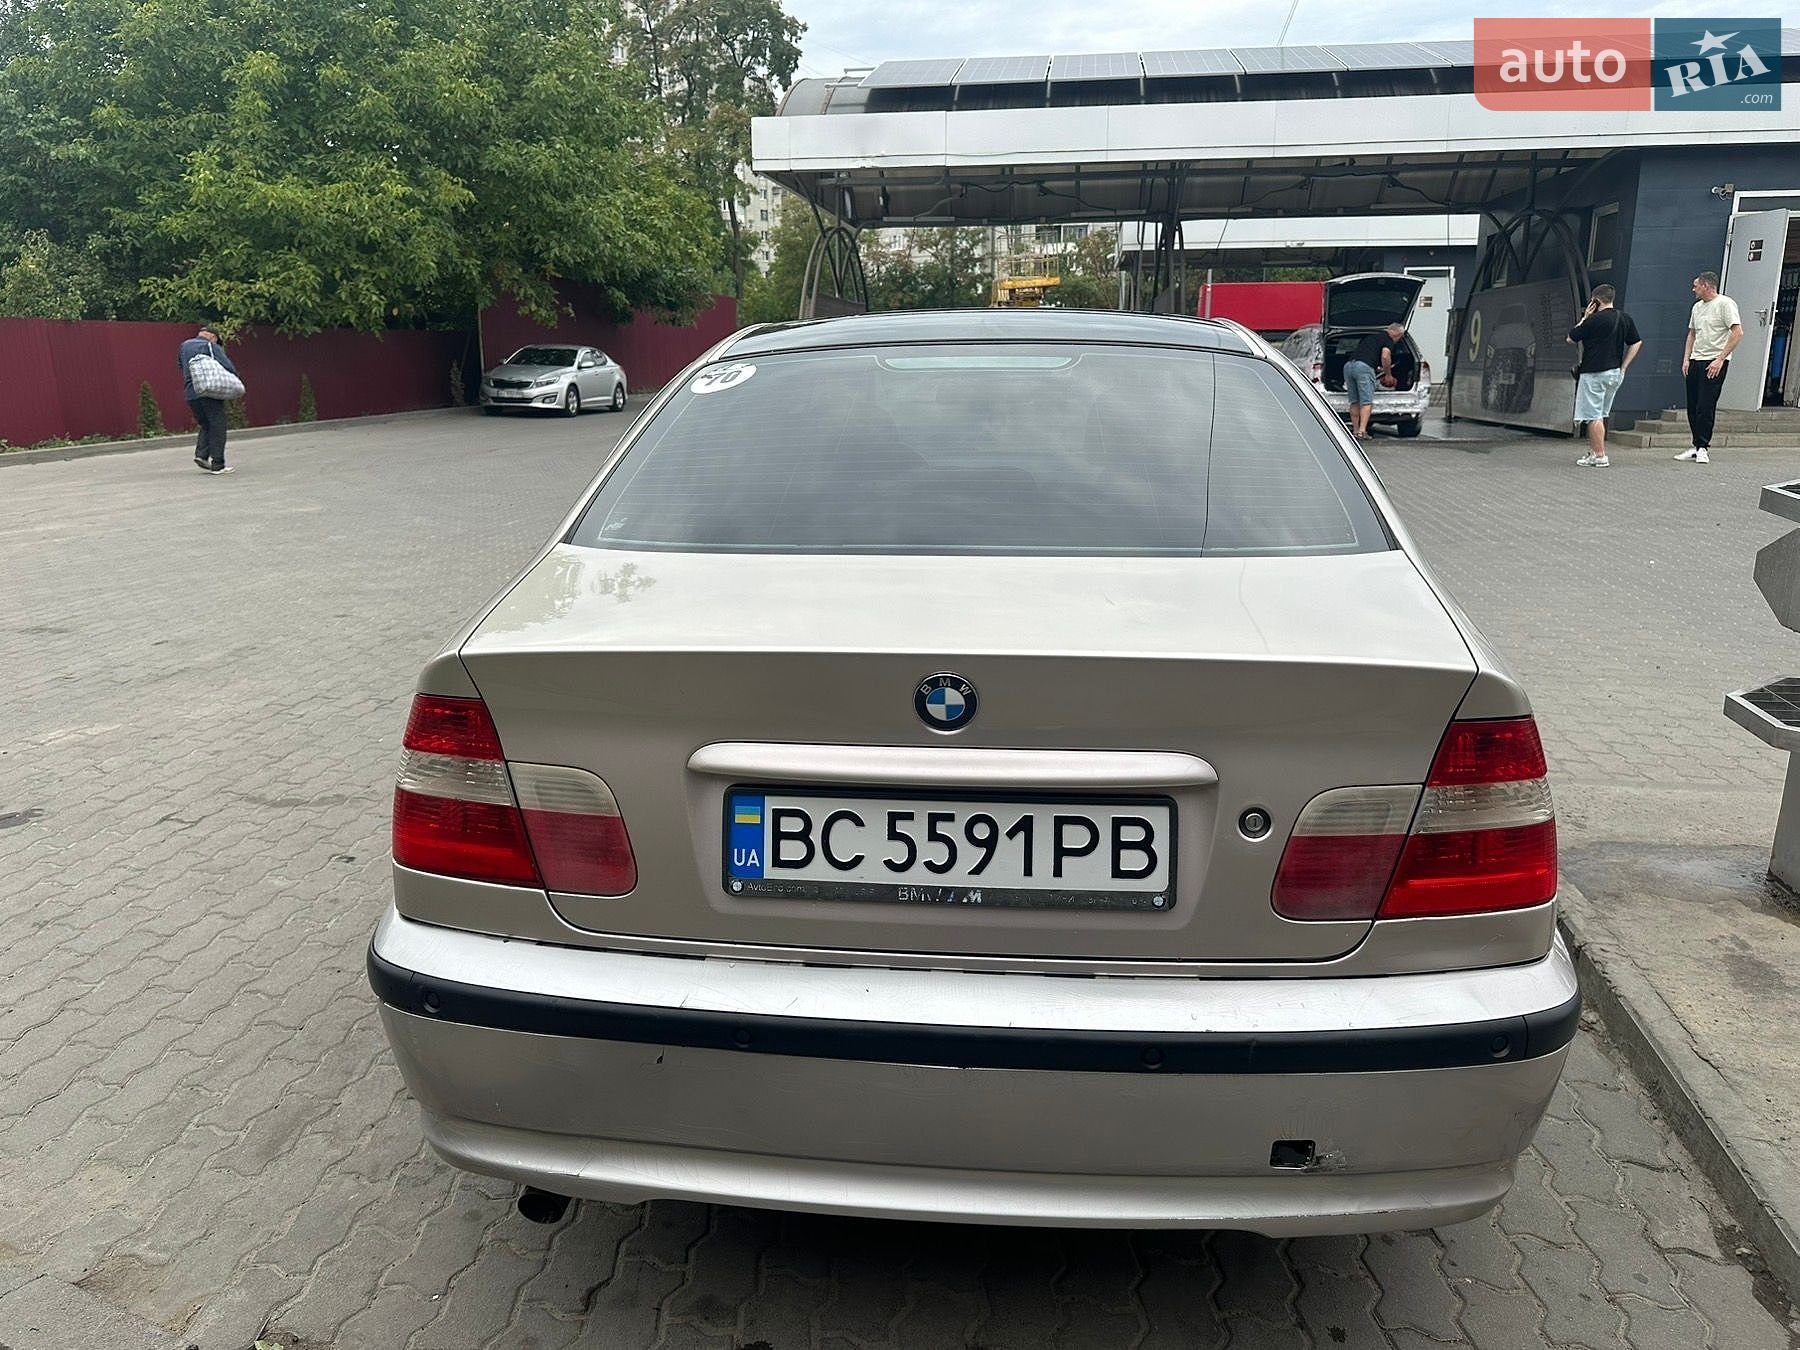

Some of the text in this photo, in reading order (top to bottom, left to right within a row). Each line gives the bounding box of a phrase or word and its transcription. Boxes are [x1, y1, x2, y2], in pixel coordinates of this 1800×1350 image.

[1469, 309, 1482, 362] 9
[920, 677, 972, 696] BMW
[733, 847, 761, 868] UA
[770, 806, 1159, 880] BC 5591 PB
